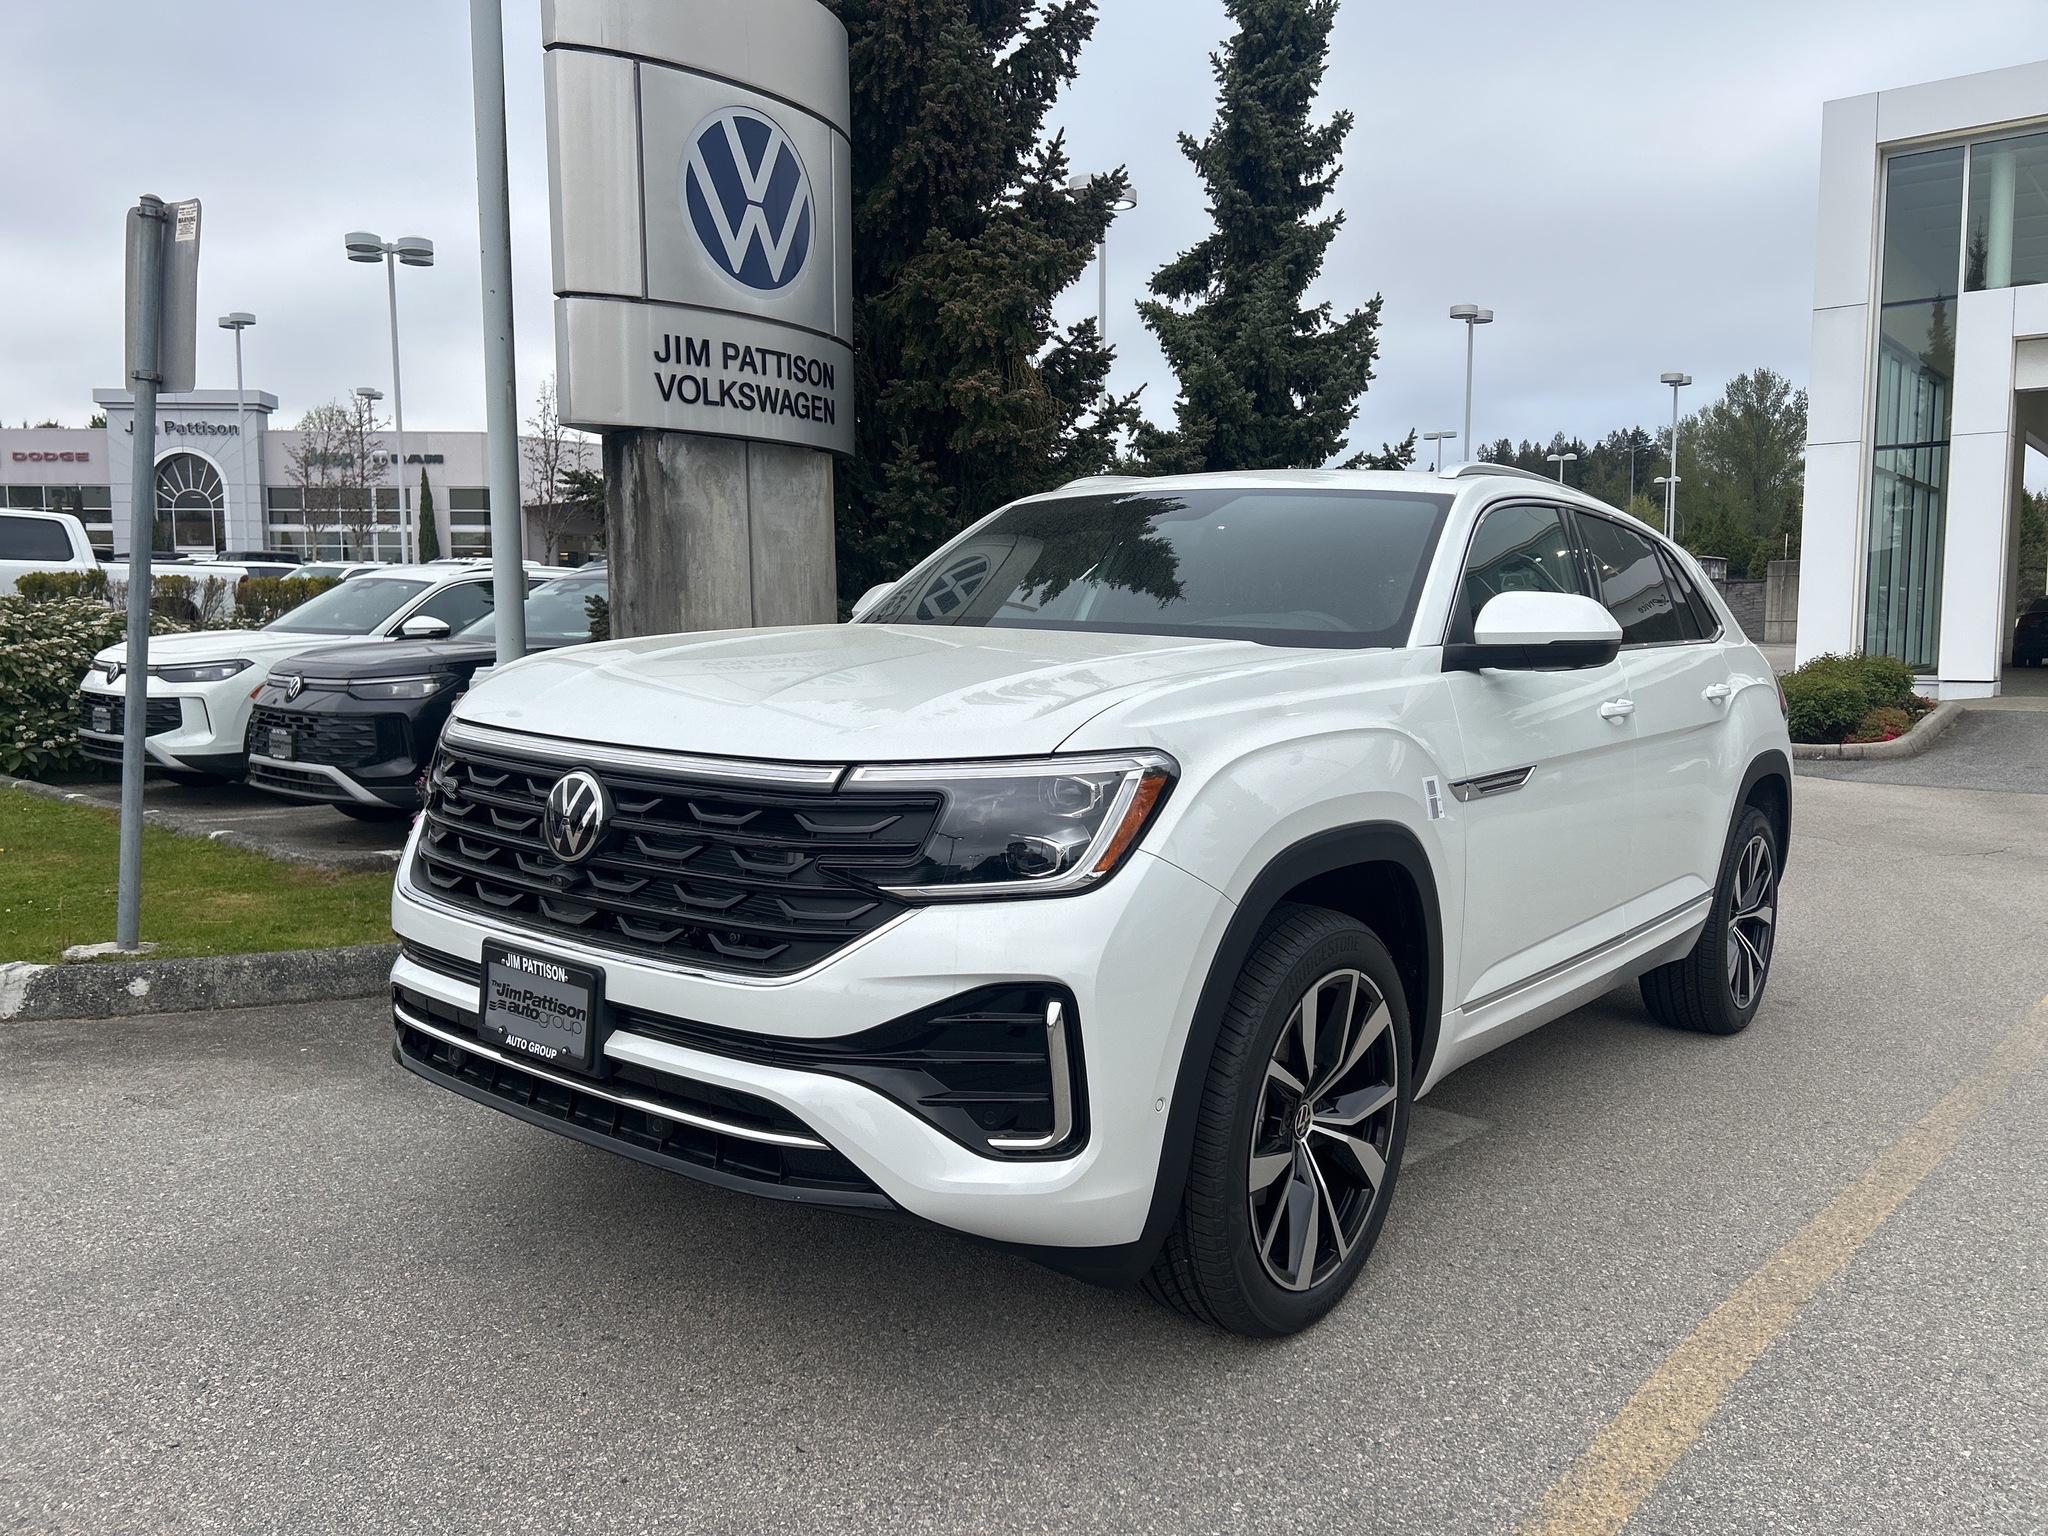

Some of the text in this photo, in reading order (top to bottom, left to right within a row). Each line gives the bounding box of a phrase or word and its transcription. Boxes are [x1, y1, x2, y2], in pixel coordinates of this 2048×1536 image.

[653, 333, 835, 391] JIM PATTISON
[653, 371, 836, 426] VOLKSWAGEN
[164, 420, 240, 436] Pattison
[12, 451, 90, 462] DODGE
[505, 952, 566, 983] JIM PATTISON
[491, 979, 502, 989] The
[505, 1034, 558, 1059] AUTO GROUP
